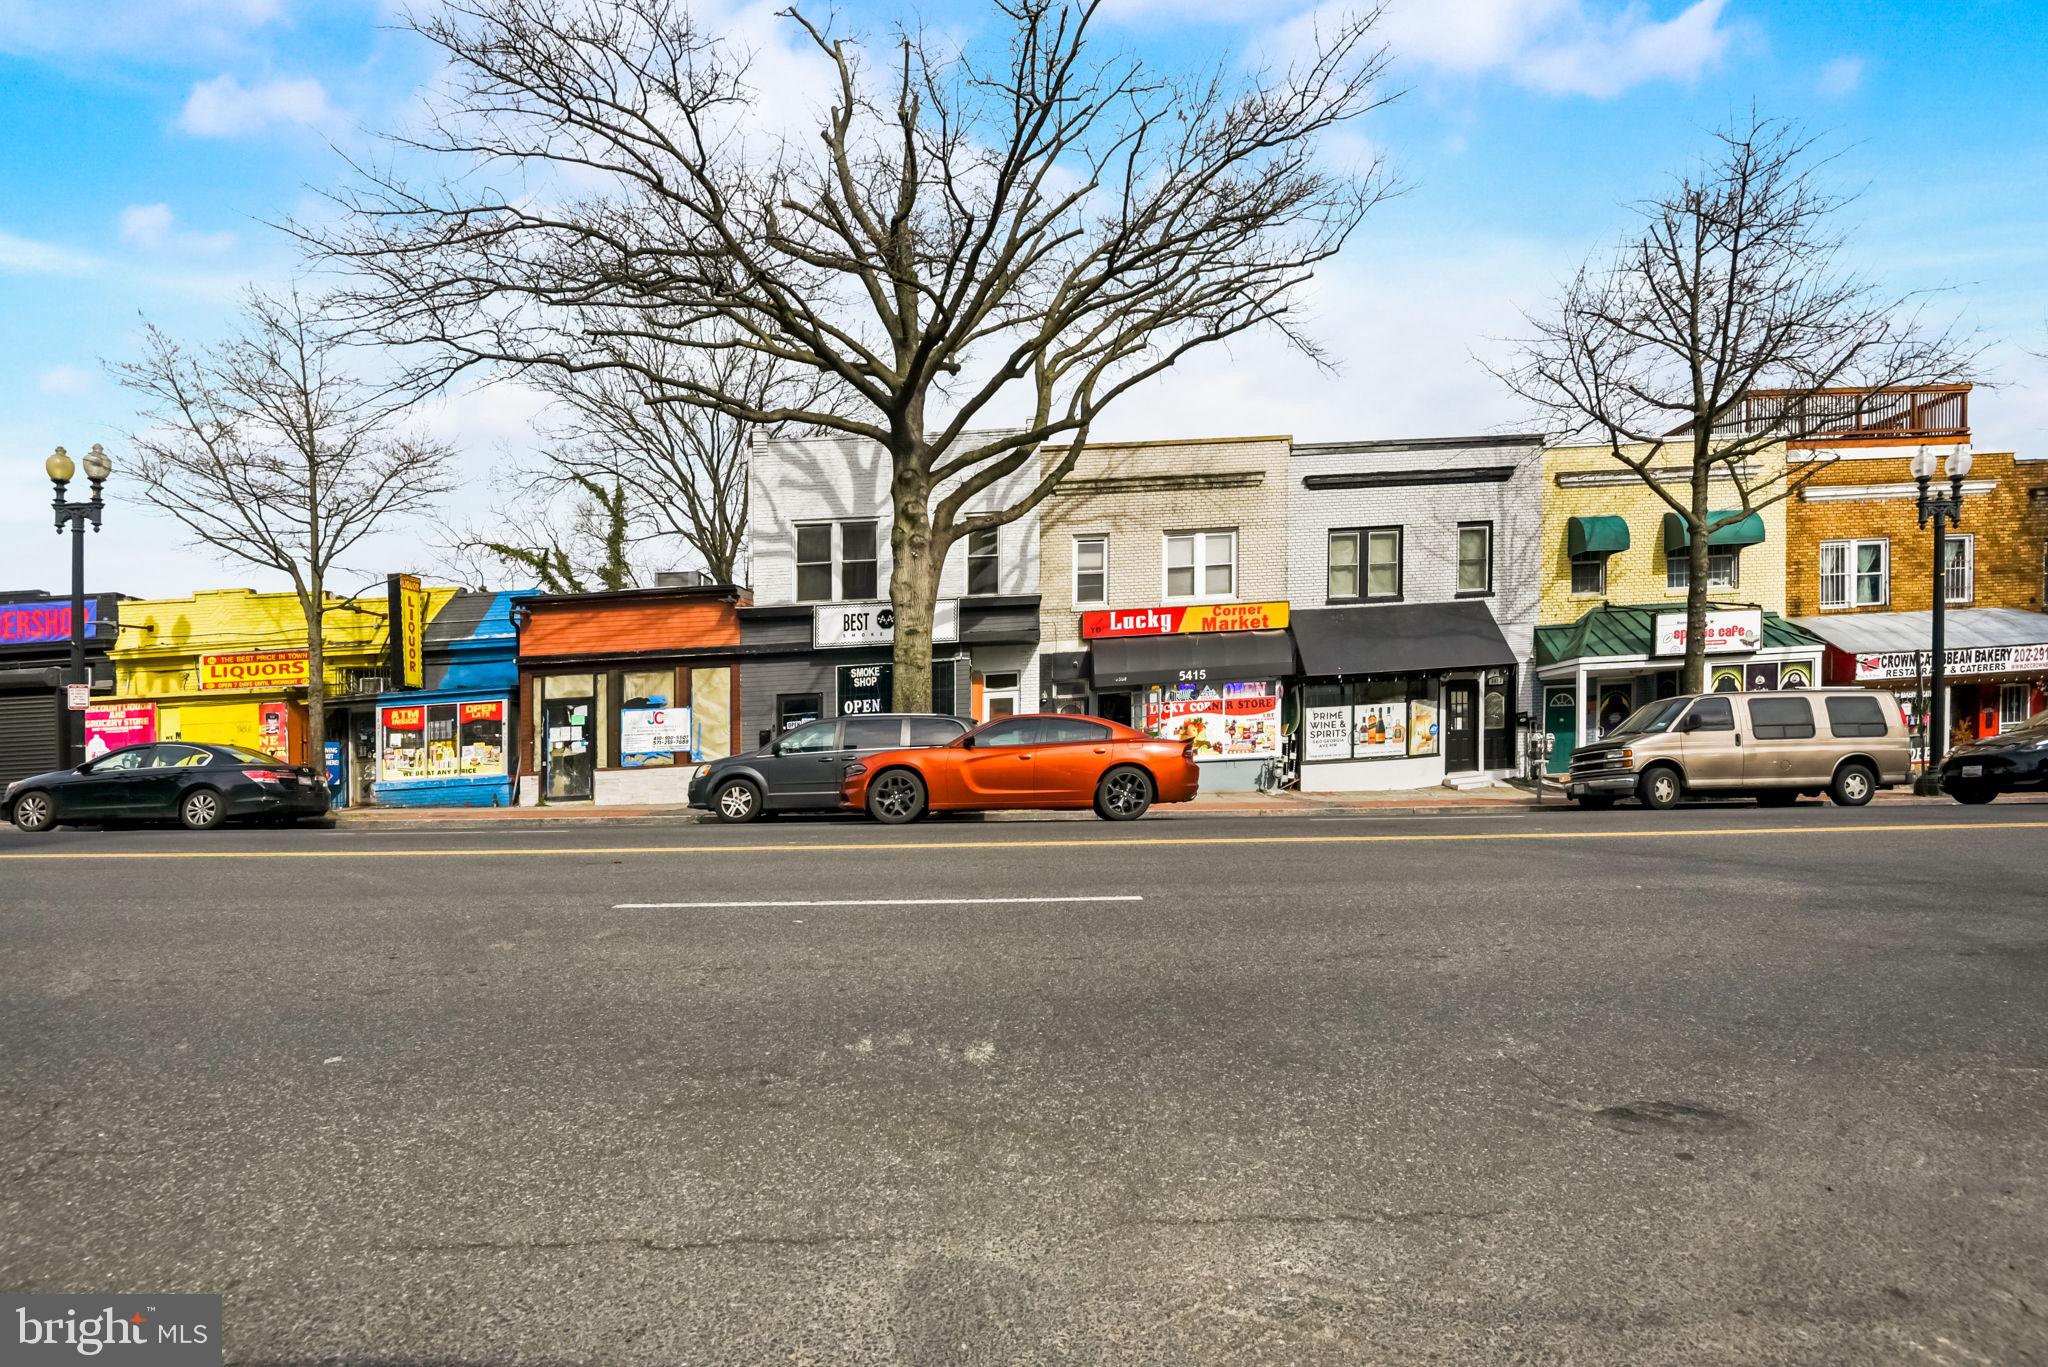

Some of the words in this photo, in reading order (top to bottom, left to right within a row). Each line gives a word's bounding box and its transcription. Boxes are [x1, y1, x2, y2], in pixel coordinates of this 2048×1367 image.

[1213, 605, 1262, 617] Corner
[843, 613, 869, 632] BEST
[1110, 610, 1171, 632] Lucky
[1202, 614, 1269, 631] Market
[408, 596, 416, 672] LIQUOR
[1718, 625, 1745, 637] cafe
[1881, 654, 1916, 668] CROWN
[1975, 648, 2012, 663] BAKERY
[211, 661, 304, 679] LIQUORS
[851, 667, 880, 678] SMOKE
[1950, 665, 1956, 673] &
[1960, 663, 2006, 673] CATERERS
[1179, 670, 1207, 681] 5415
[854, 677, 877, 687] SHOP
[466, 704, 496, 713] OPEN
[844, 699, 880, 713] OPEN
[1149, 703, 1185, 715] LUCKY
[1238, 699, 1272, 709] STORE
[391, 710, 419, 719] ATM
[647, 711, 664, 725] JC
[1313, 711, 1343, 720] PRIME
[86, 719, 123, 728] GROCERY
[123, 717, 149, 725] STORE
[1310, 721, 1337, 729] WINE
[1340, 720, 1346, 728] &
[1310, 729, 1347, 739] SPIRITS
